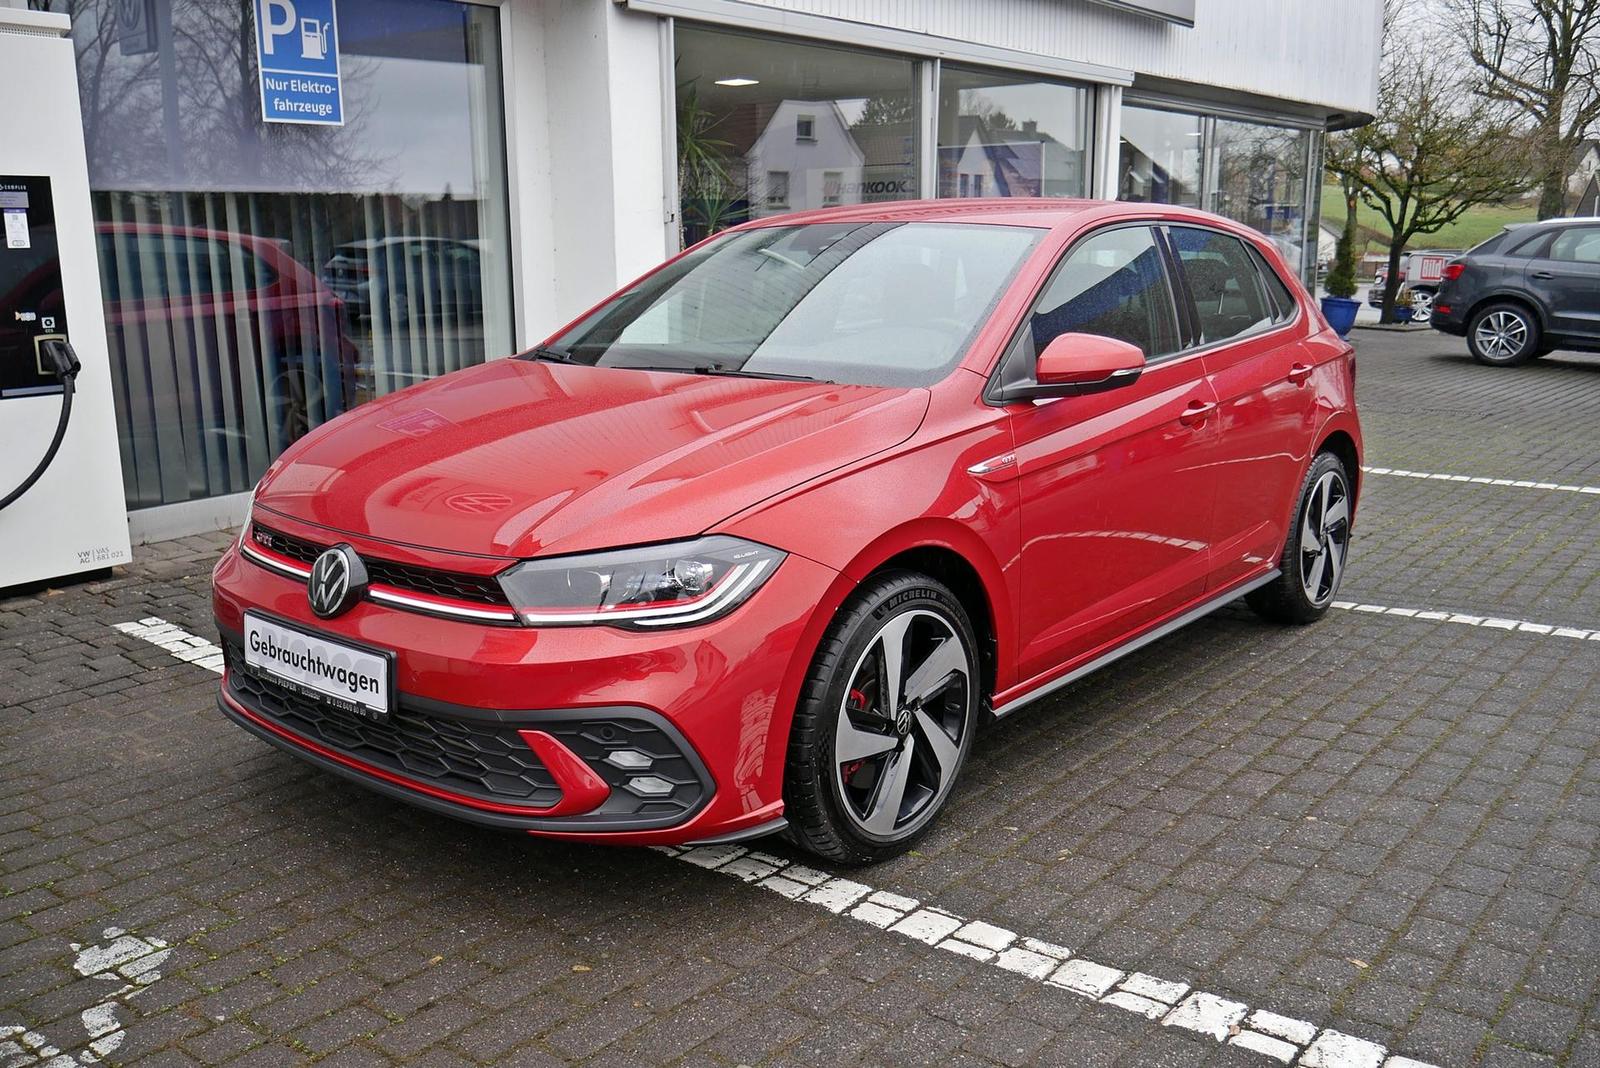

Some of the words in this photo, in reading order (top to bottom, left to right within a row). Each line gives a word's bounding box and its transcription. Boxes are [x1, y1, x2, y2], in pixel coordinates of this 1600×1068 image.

[261, 0, 297, 55] P
[265, 78, 288, 91] Nur
[290, 80, 336, 94] Elektro-
[273, 97, 333, 116] fahrzeuge
[256, 531, 273, 547] GTI
[888, 588, 939, 609] MICHELIN
[249, 629, 380, 694] Gebrauchtwagen
